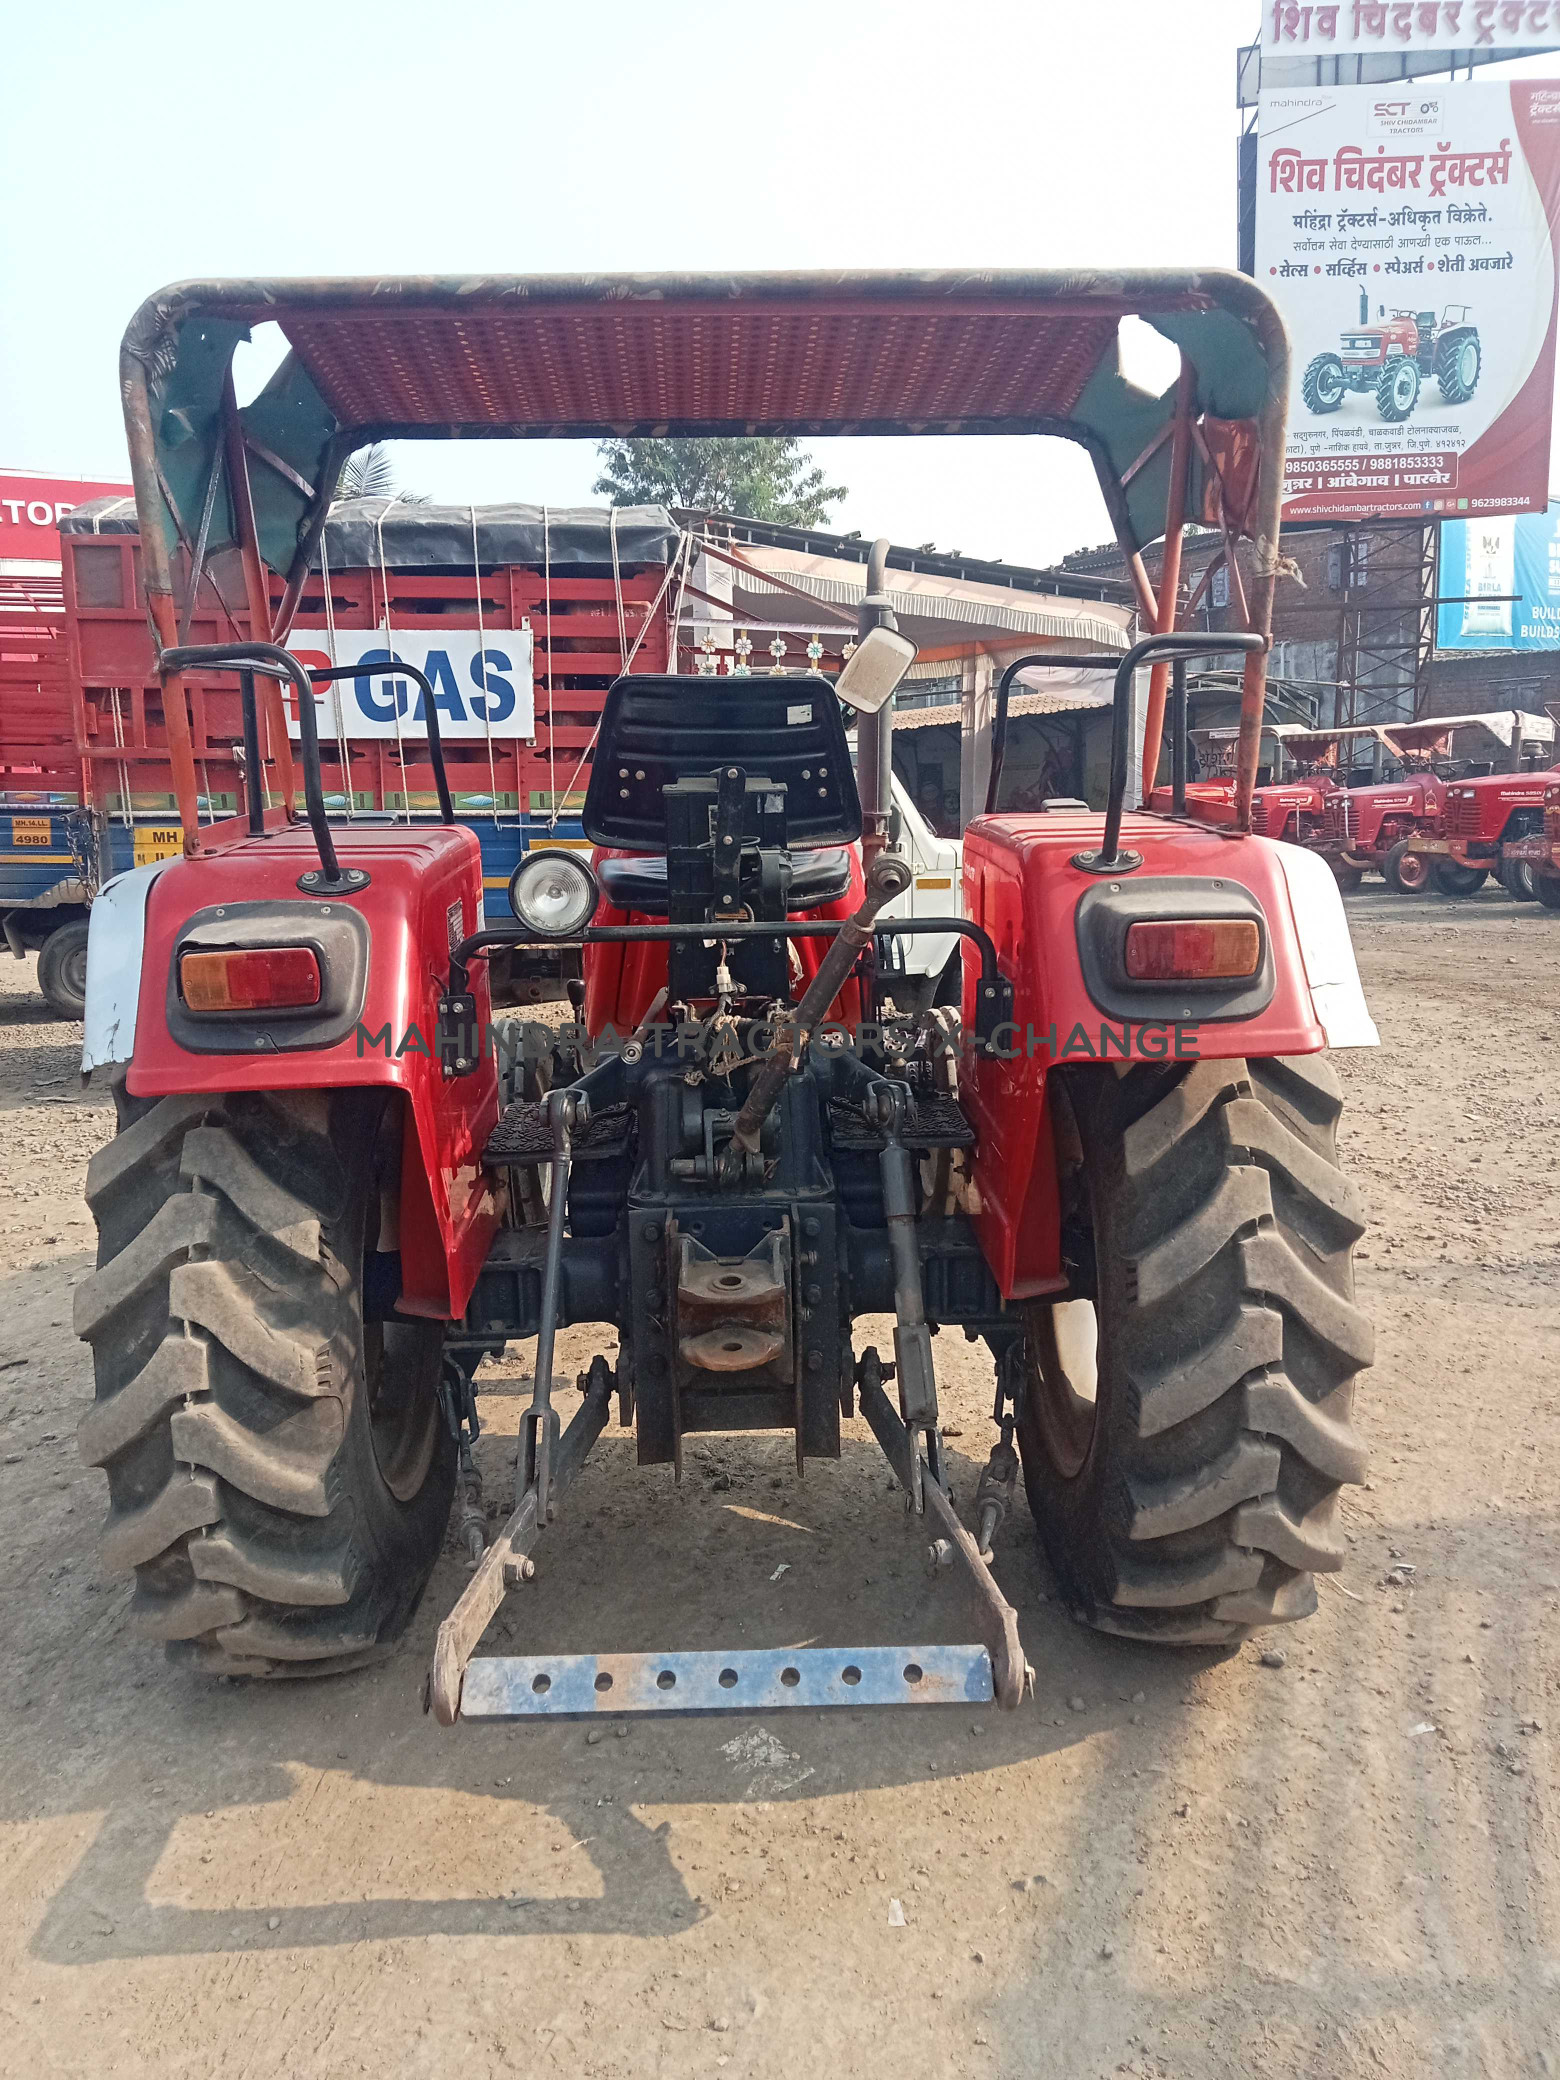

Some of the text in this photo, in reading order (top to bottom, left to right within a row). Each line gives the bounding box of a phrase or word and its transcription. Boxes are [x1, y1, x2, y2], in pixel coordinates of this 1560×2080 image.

[1270, 98, 1323, 108] mahindra
[1373, 102, 1411, 117] SCT
[1380, 118, 1438, 127] SHIV CHIDAMBAR
[1389, 127, 1424, 135] TRACTORS
[1269, 138, 1512, 197] शिव चिदंबर ट्रॅक्टर्स
[1292, 208, 1332, 231] महिंद्रा
[1446, 202, 1493, 224] विक्रेते.
[1293, 237, 1325, 251] सर्वोत्तम
[1329, 236, 1347, 251] सेवा
[1350, 235, 1394, 251] देण्यासाठी
[1397, 234, 1431, 248] आणखी
[1434, 236, 1451, 248] एक
[1279, 259, 1309, 277] सेल्स
[1384, 255, 1424, 274] स्पेअर्स
[1437, 254, 1466, 272] शेती
[1469, 251, 1513, 271] अवजारे
[1310, 443, 1321, 455] पुणे
[1285, 459, 1360, 473] 9850365555
[1370, 456, 1444, 470] 9881853333
[1327, 472, 1390, 487] आंबेगाव
[1403, 469, 1451, 485] पारनेर
[0, 499, 78, 526] TO
[1289, 502, 1421, 514] www.shivchidambartractors.com
[1471, 496, 1530, 508] 9623983344
[354, 649, 516, 723] GAS
[16, 835, 48, 844] 4980
[152, 831, 178, 843] MH
